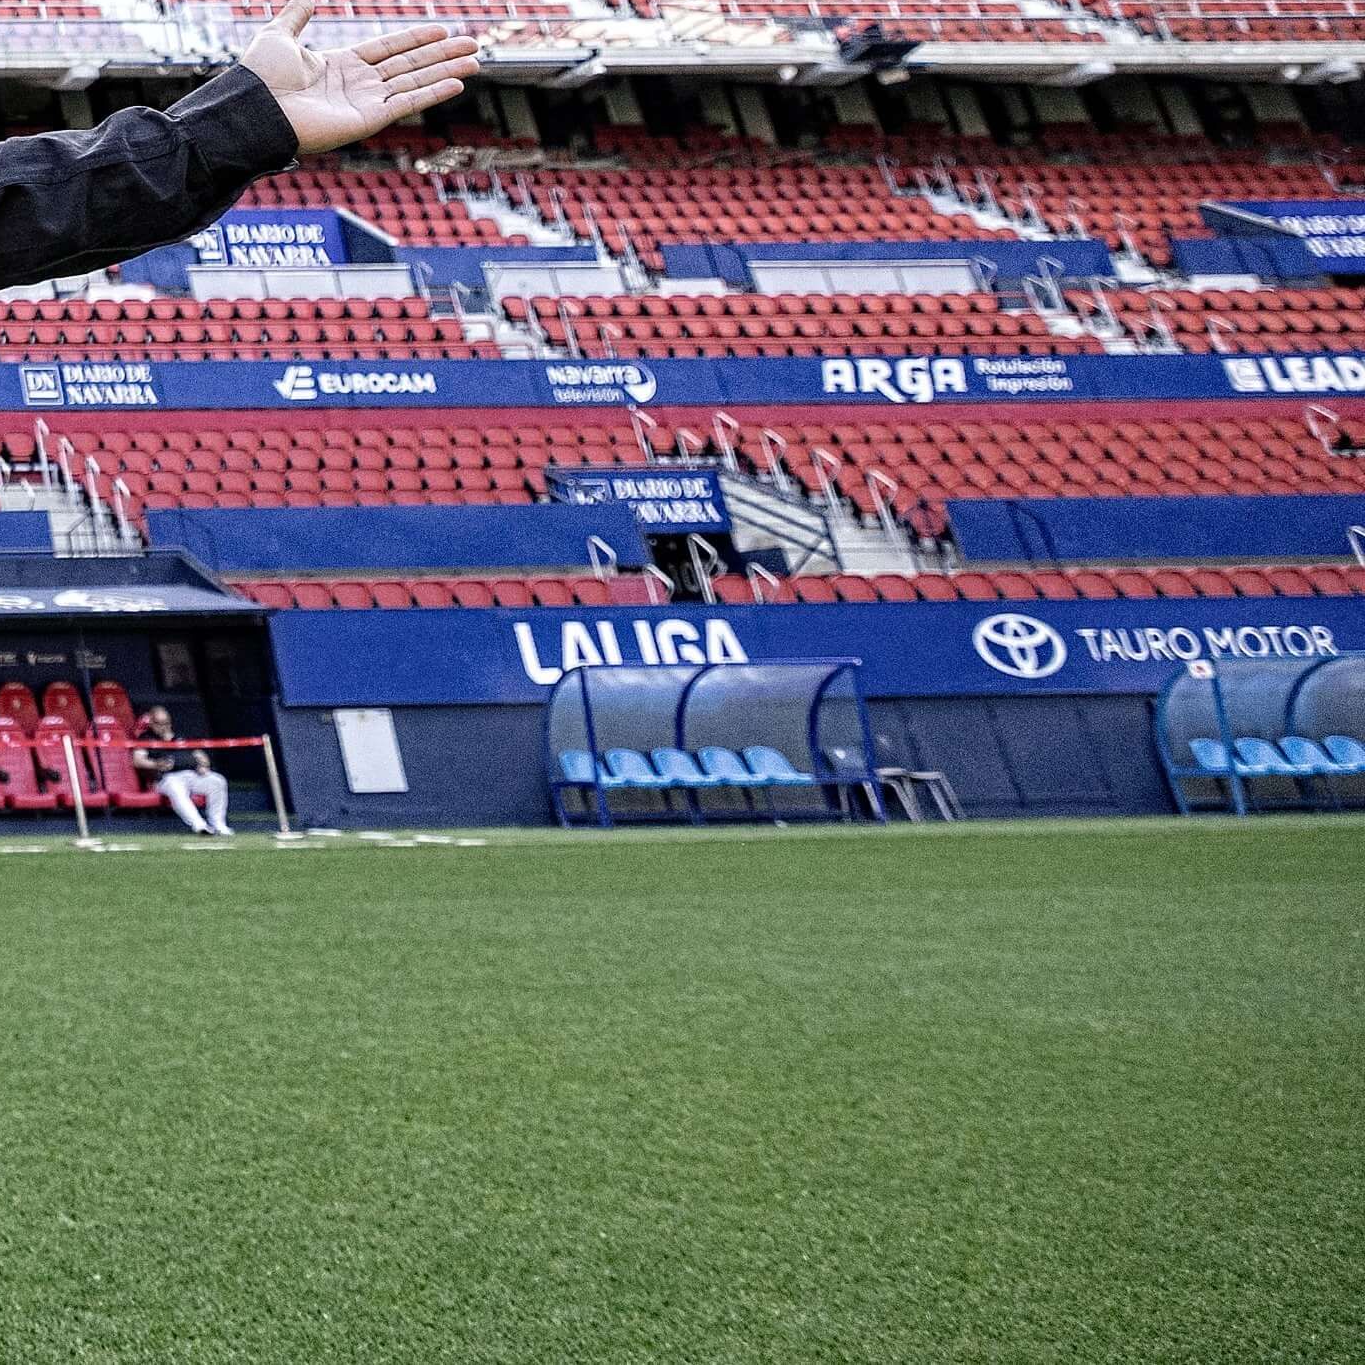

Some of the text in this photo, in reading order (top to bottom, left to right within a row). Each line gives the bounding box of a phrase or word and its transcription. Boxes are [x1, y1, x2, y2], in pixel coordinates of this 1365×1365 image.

[226, 224, 325, 244] DIARIO DE
[230, 245, 332, 266] NAVARRA
[26, 371, 57, 391] DN
[63, 365, 152, 383] DIARIO DE
[318, 372, 437, 394] EUROCAM
[821, 358, 969, 403] ARGA
[1259, 356, 1365, 392] LEAD
[66, 384, 158, 404] NAVARRA
[512, 618, 750, 685] LALIGA
[1075, 625, 1341, 661] TAURO MOTOR
